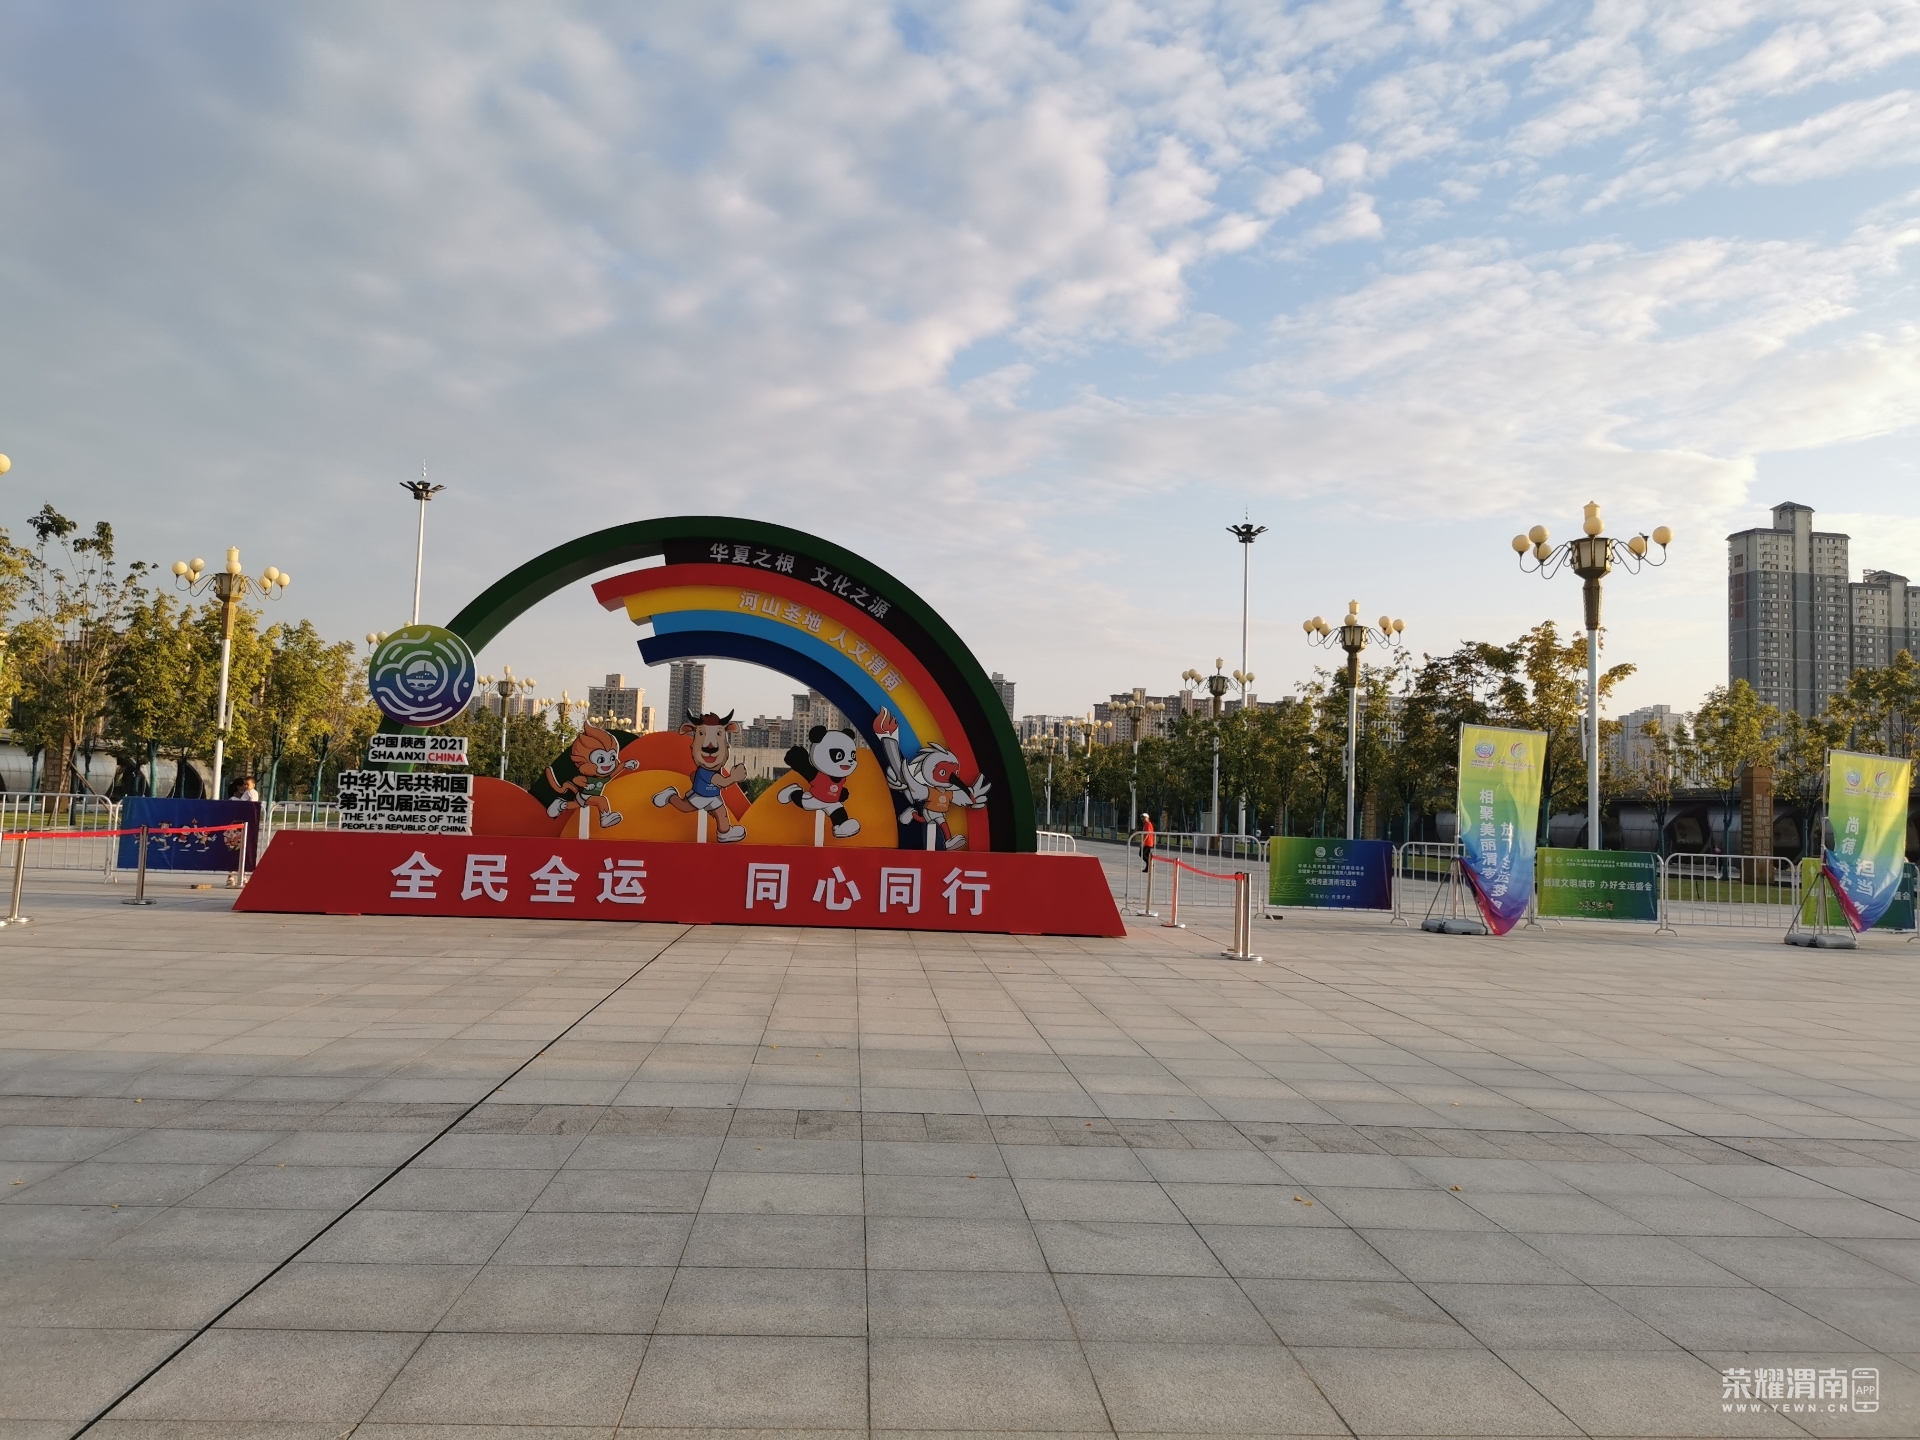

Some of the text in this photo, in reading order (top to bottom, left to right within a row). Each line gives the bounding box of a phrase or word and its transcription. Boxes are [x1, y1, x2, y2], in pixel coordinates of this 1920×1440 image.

[710, 543, 891, 619] 华夏之根 文化之源
[738, 590, 903, 691] 河山圣地 人文渭南
[372, 736, 463, 750] 中国 陕西 2021
[371, 750, 464, 762] SHAANXI CHINA
[340, 772, 468, 793] 中华人民共和国
[339, 792, 468, 813] 第十四届运动会
[343, 813, 364, 821] THE
[387, 814, 426, 823] GAMES
[429, 815, 443, 823] OF
[446, 815, 467, 824] THE
[1479, 789, 1497, 879] 相聚美丽渭南
[390, 851, 990, 916] 全民全运 同心同行
[1305, 878, 1357, 887] 火炬传递渭南市区站
[1543, 878, 1653, 891] 创建文明城市 办好全运盛会
